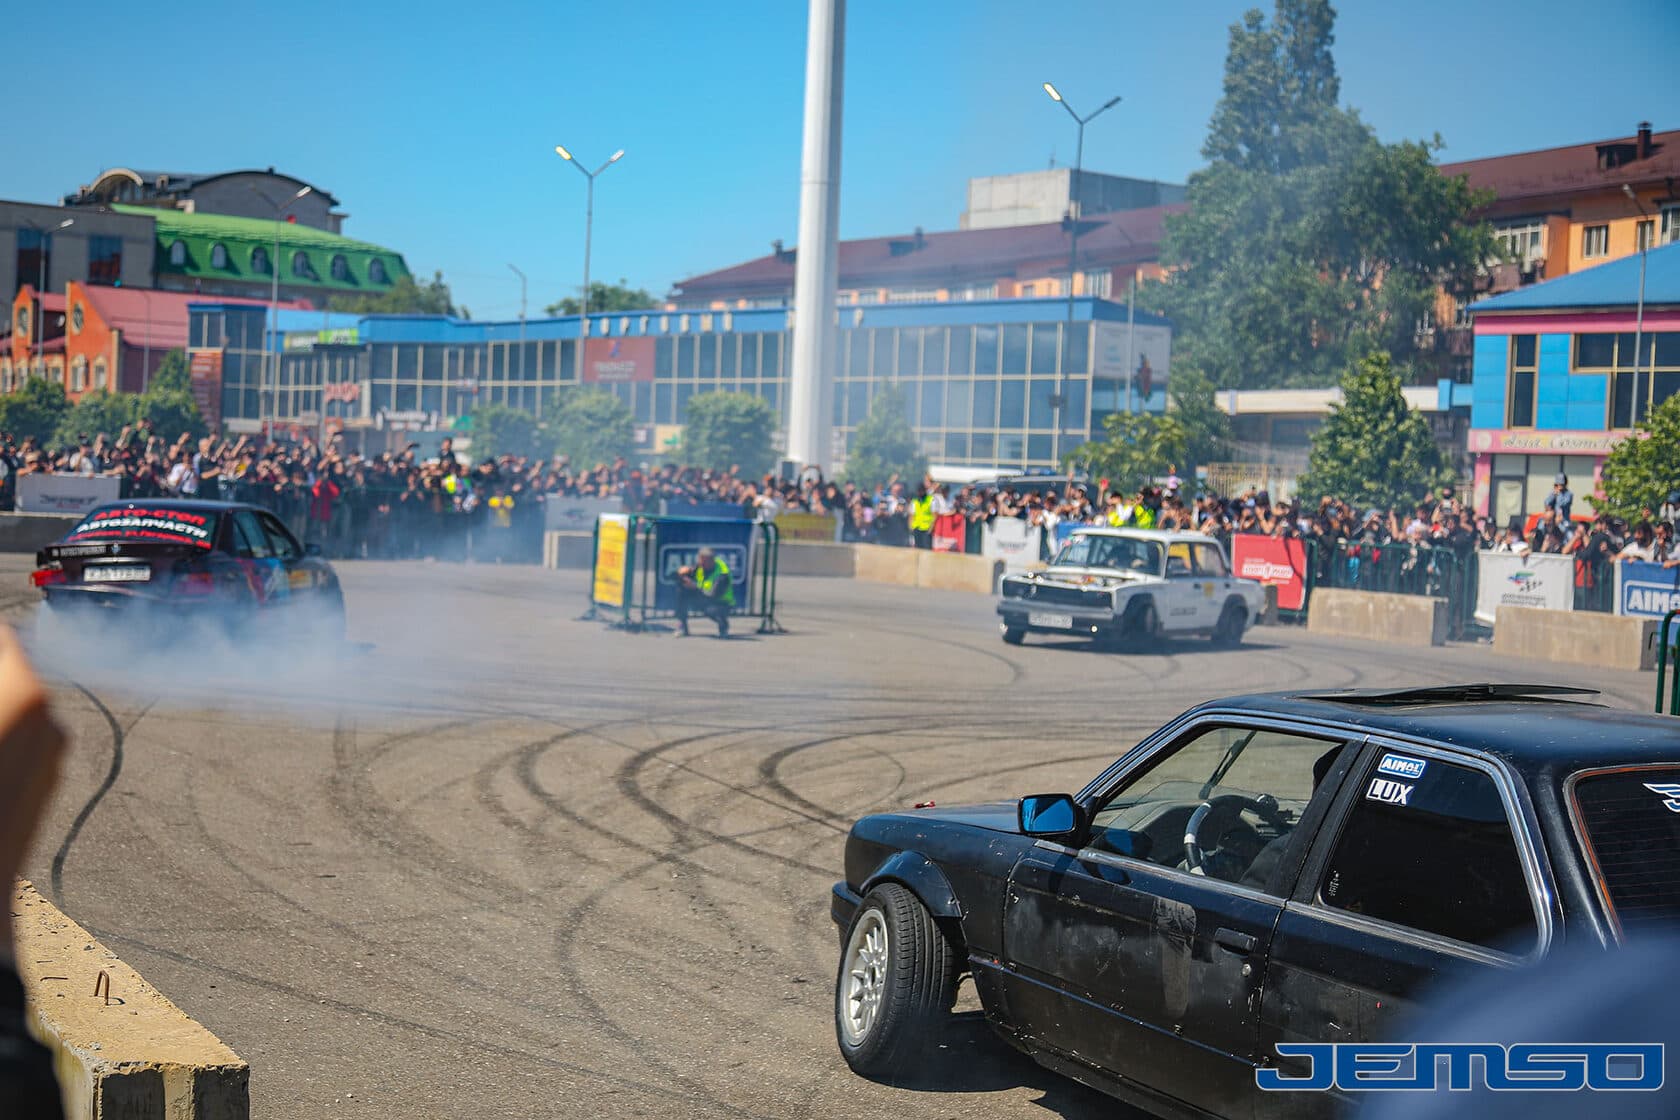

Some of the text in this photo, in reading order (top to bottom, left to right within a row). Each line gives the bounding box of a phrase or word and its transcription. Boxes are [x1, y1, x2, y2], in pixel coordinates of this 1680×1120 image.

[95, 509, 206, 526] АВТО-СТОП
[76, 518, 209, 538] АВТОЗАПЧАСТИ
[1381, 757, 1420, 773] AIMOL
[1368, 779, 1415, 805] LUX
